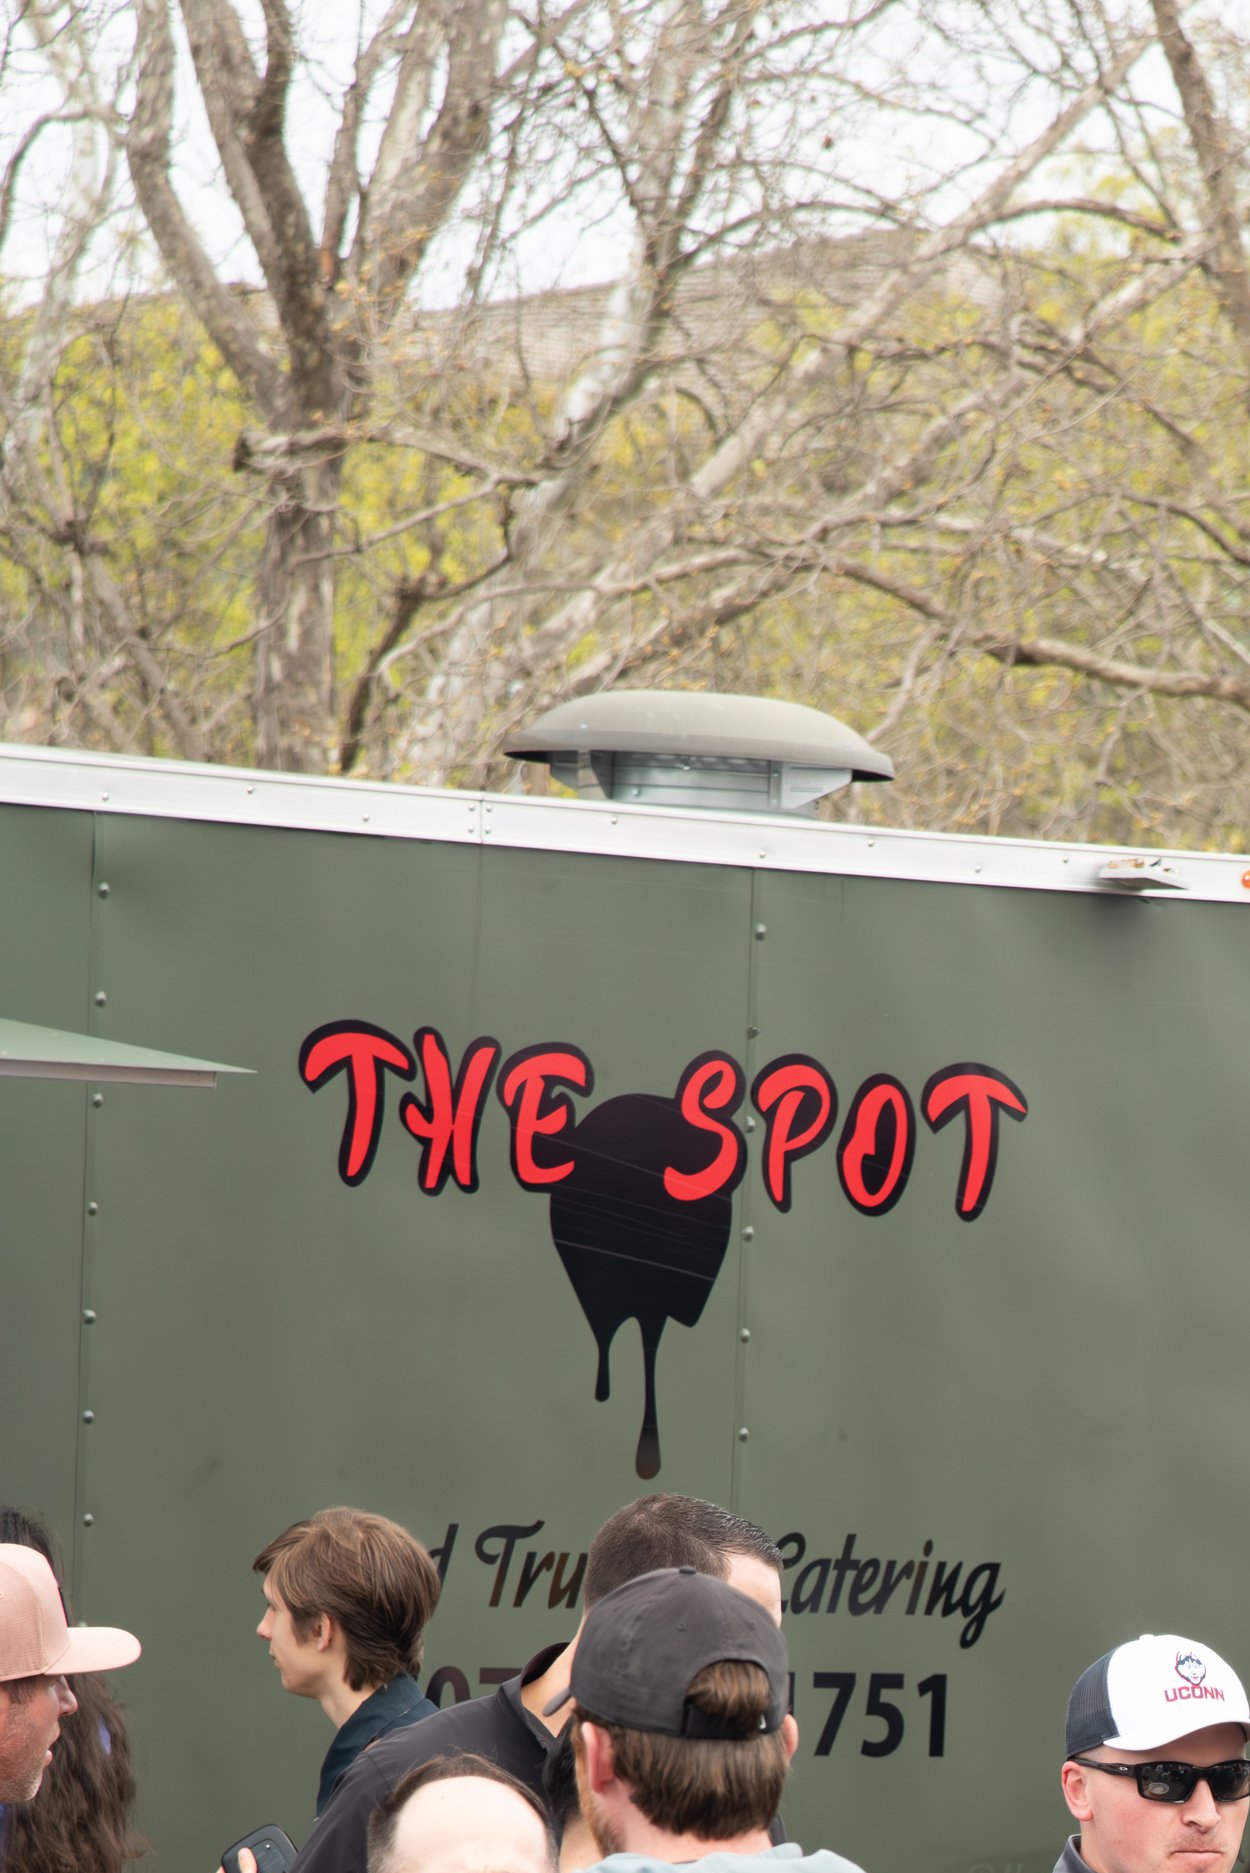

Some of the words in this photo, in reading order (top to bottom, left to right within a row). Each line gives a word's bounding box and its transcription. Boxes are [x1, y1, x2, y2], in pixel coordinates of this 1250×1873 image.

[298, 1019, 593, 1197] THE
[663, 1050, 1029, 1222] SPOT
[475, 1520, 588, 1609] Tru
[788, 1672, 947, 1757] 751
[1163, 1686, 1225, 1702] UCONN
